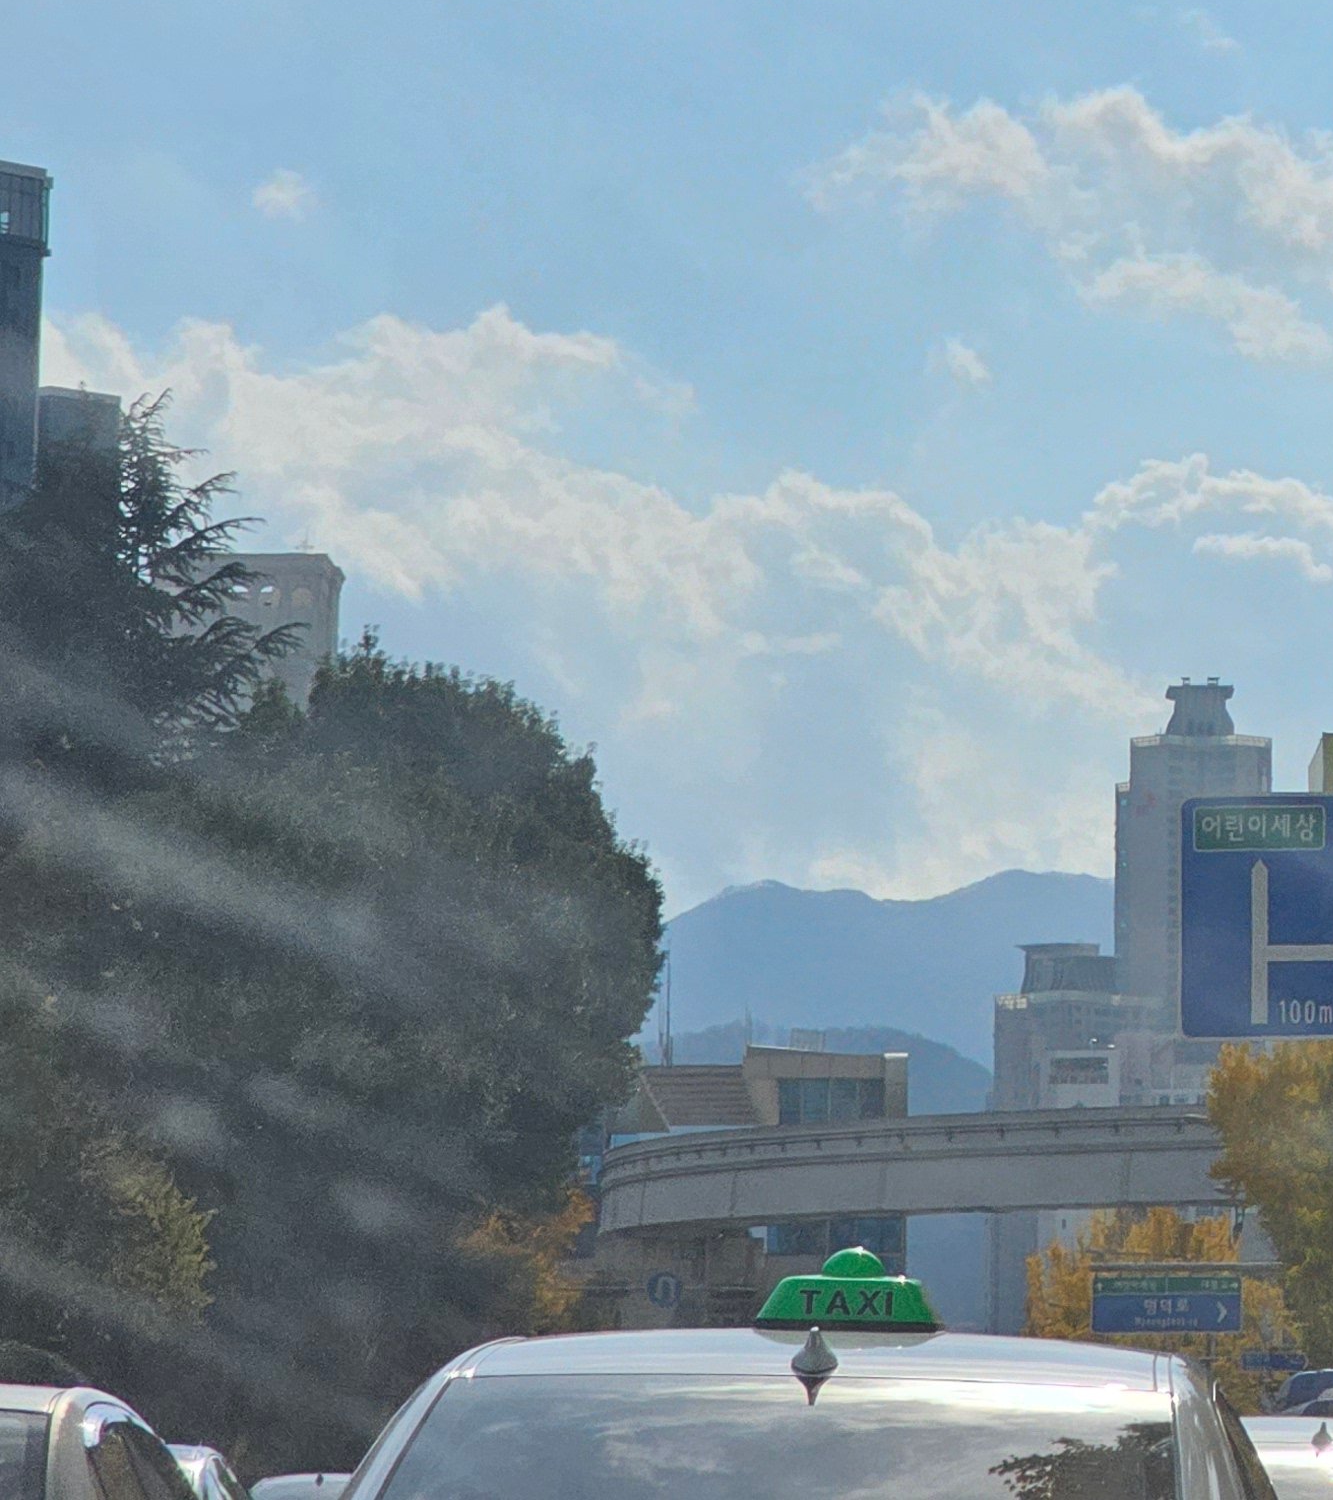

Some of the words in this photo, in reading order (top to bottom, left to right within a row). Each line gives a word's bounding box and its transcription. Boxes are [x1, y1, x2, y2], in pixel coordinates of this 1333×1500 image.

[1201, 812, 1317, 844] 어린이세상
[1278, 1000, 1333, 1025] 100m
[799, 1289, 894, 1317] TAXI
